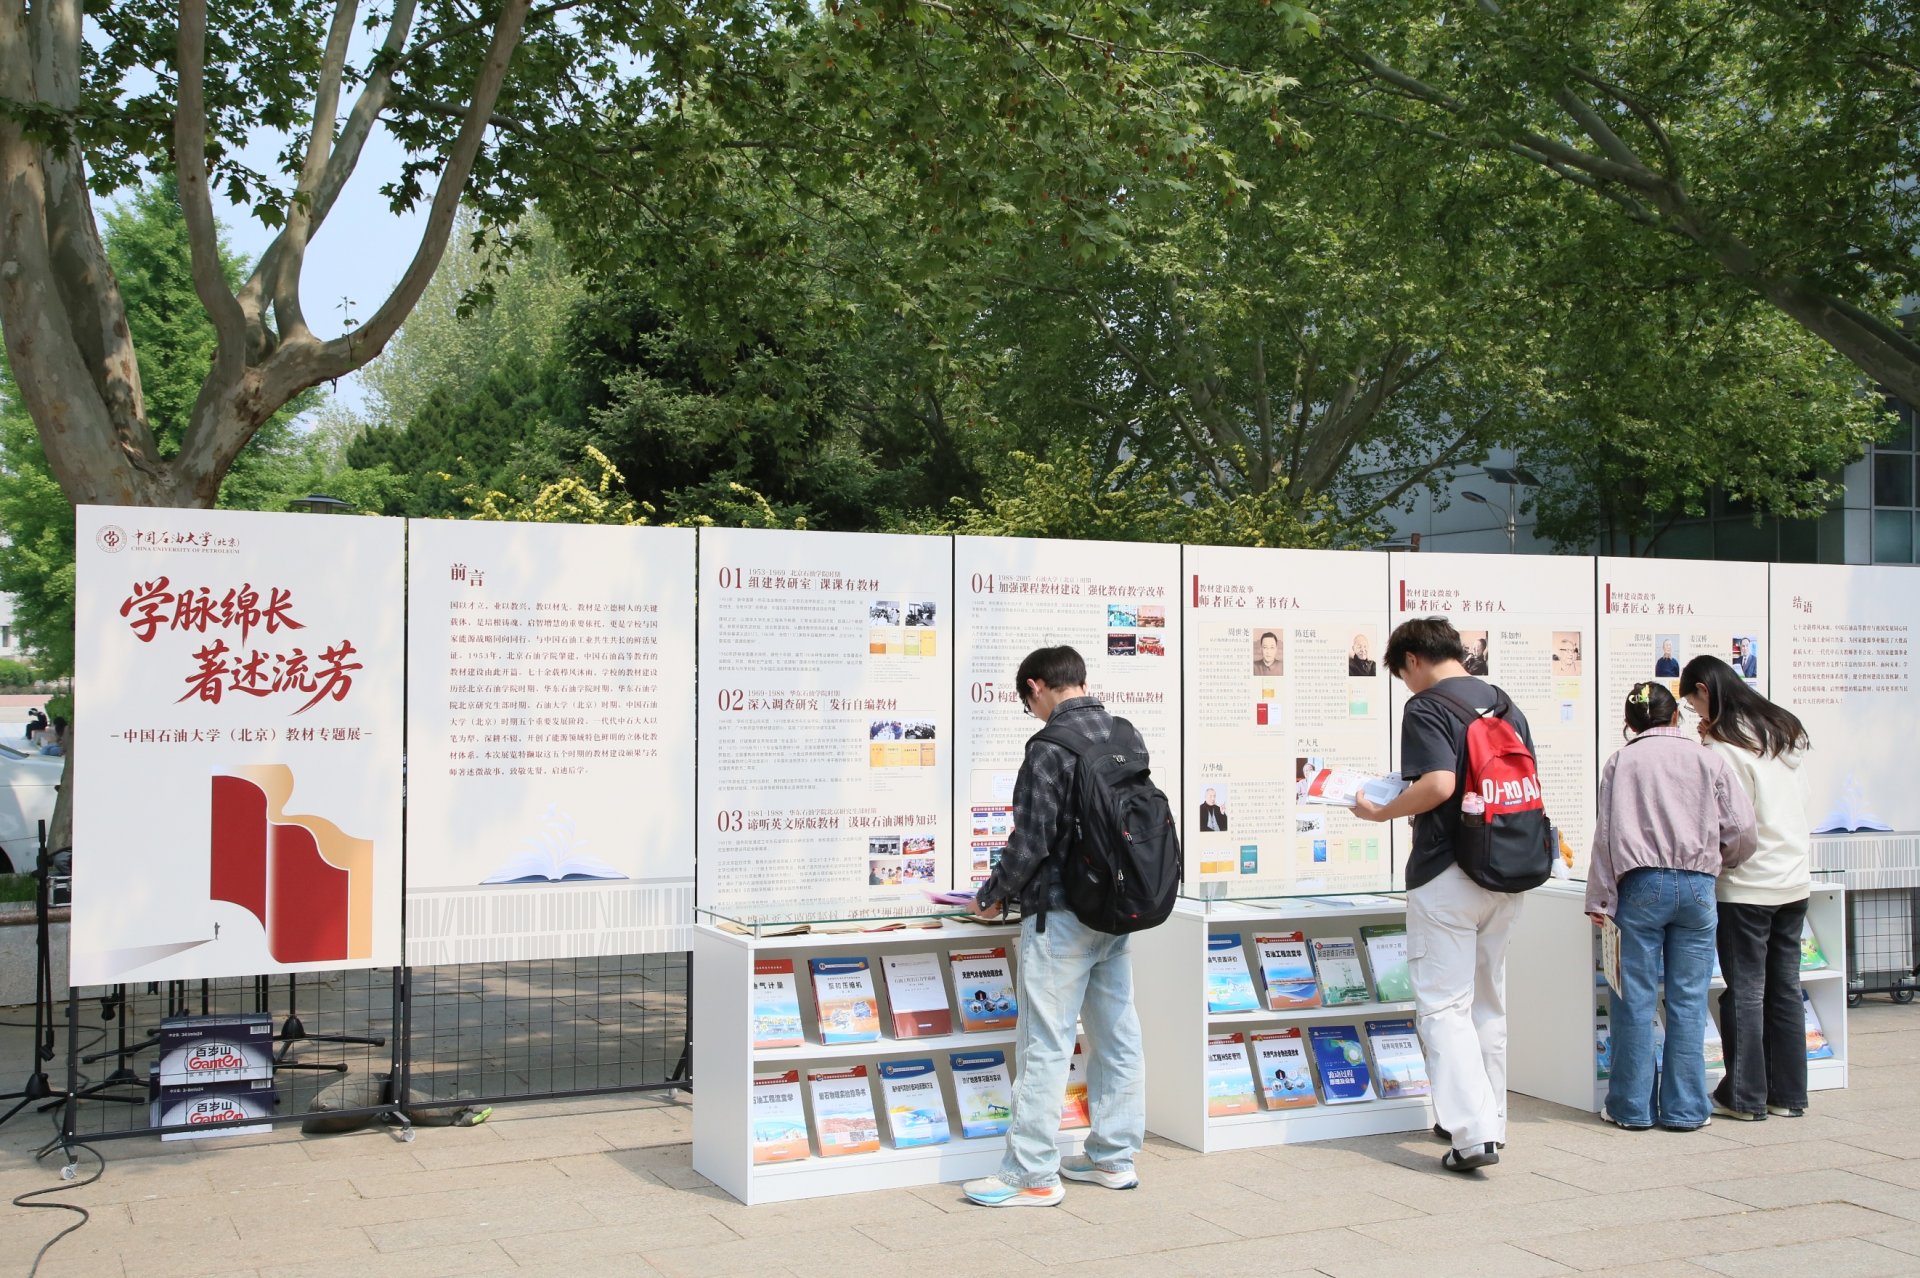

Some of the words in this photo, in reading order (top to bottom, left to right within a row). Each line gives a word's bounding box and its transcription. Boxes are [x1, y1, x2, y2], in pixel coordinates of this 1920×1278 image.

[450, 563, 484, 587] 前言
[718, 567, 742, 589] 01
[972, 573, 994, 594] 04
[748, 577, 812, 590] 组建教研室
[820, 579, 880, 592] 课课有教材
[999, 582, 1080, 595] 加强课程教材建设
[1088, 585, 1164, 598] 强化教育教学改革
[1200, 595, 1246, 608] 师者匠心
[1256, 596, 1300, 609] 著书育人
[1406, 600, 1452, 611] 师者匠心
[1463, 600, 1506, 612] 著书育人
[1612, 602, 1650, 614] 师者匠心
[1658, 604, 1694, 614] 著书育人
[120, 576, 307, 648] 学脉绵长
[173, 638, 363, 716] 著述流芳
[718, 688, 744, 711] 02
[972, 682, 994, 702] 05
[748, 698, 818, 710] 深入调查研究
[830, 698, 898, 710] 发行自编教材
[718, 810, 742, 832] 03
[748, 818, 840, 831] 谛听英文原版教材
[848, 814, 937, 828] 汲取石油渊博知识
[196, 1046, 231, 1057] 百岁山
[198, 1102, 232, 1112] 百岁山
